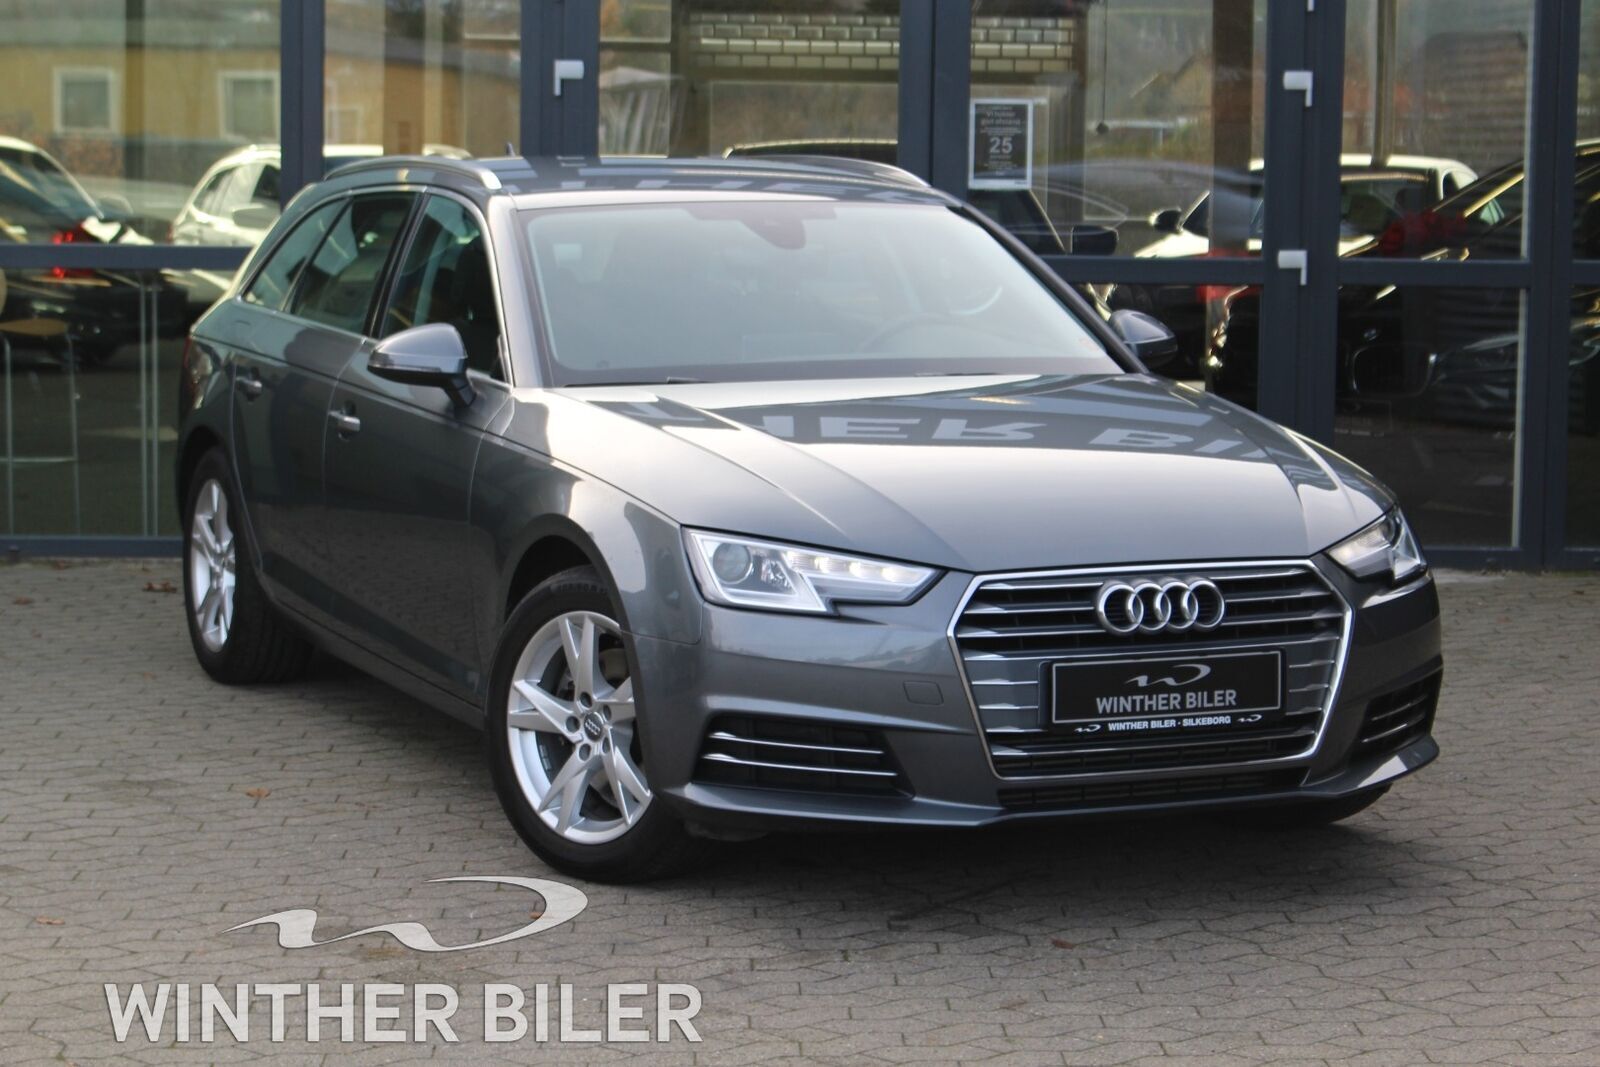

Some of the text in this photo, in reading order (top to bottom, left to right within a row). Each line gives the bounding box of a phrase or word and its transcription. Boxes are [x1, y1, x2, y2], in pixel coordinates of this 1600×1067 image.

[989, 137, 1013, 154] 25
[1096, 689, 1237, 714] WINTHER BILER
[1108, 716, 1231, 731] WINTHER BILER SILKEBORG
